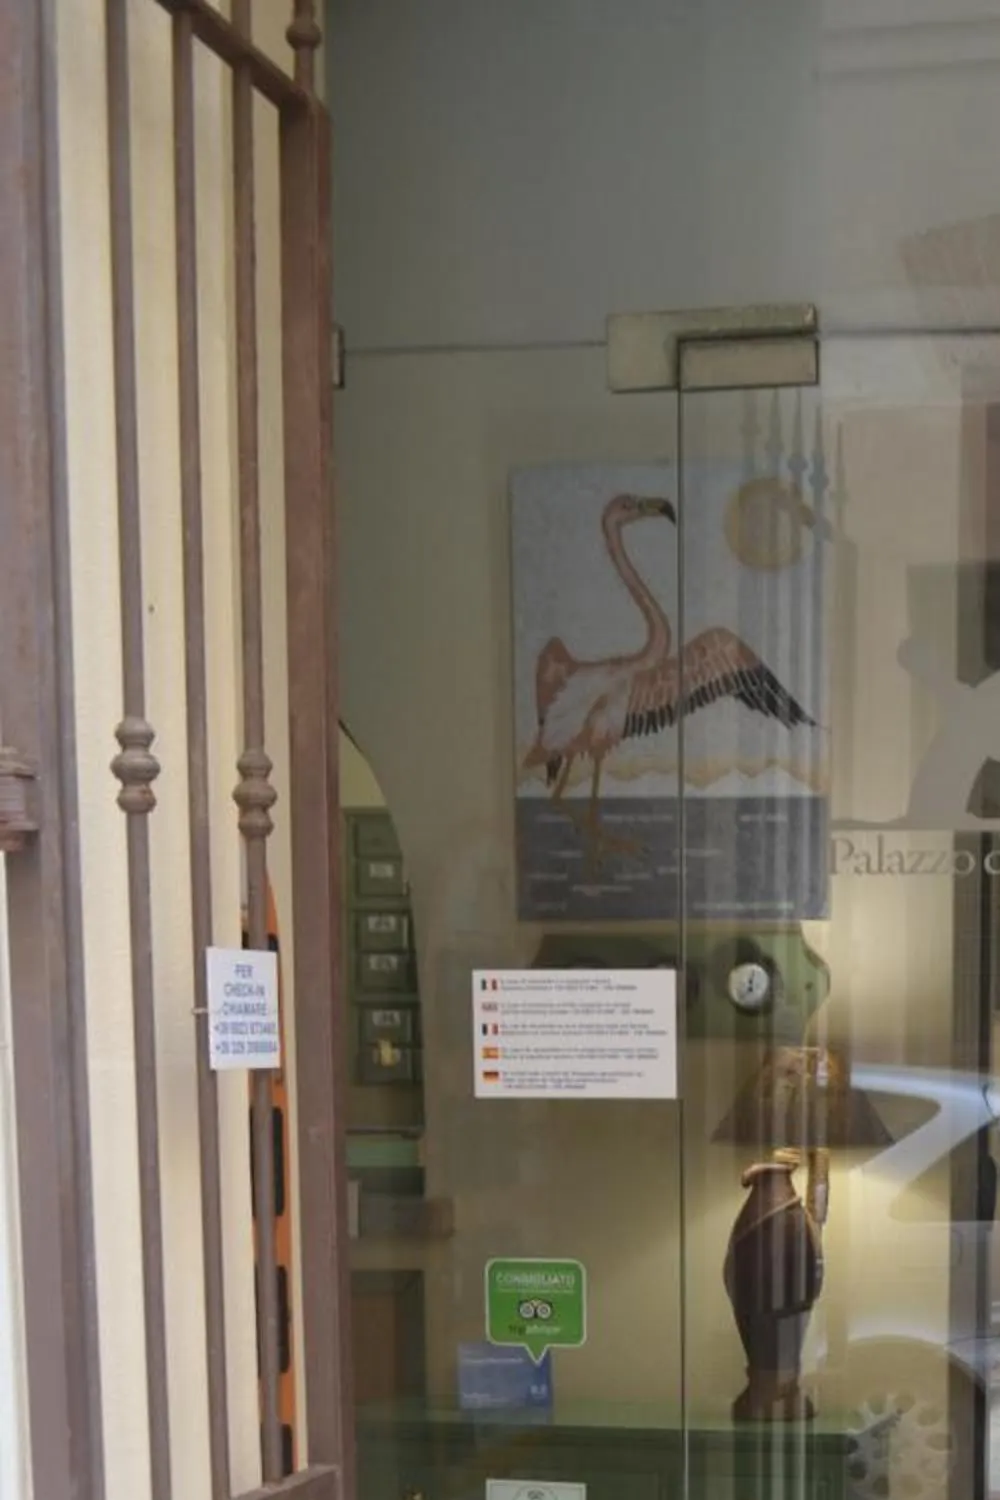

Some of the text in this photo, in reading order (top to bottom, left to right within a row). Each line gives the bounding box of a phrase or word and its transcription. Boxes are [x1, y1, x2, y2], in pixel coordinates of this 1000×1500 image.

[828, 832, 975, 876] Palazzo
[234, 963, 253, 979] PER
[223, 982, 265, 997] CHECK-IN
[223, 1001, 268, 1016] CHIAMARE
